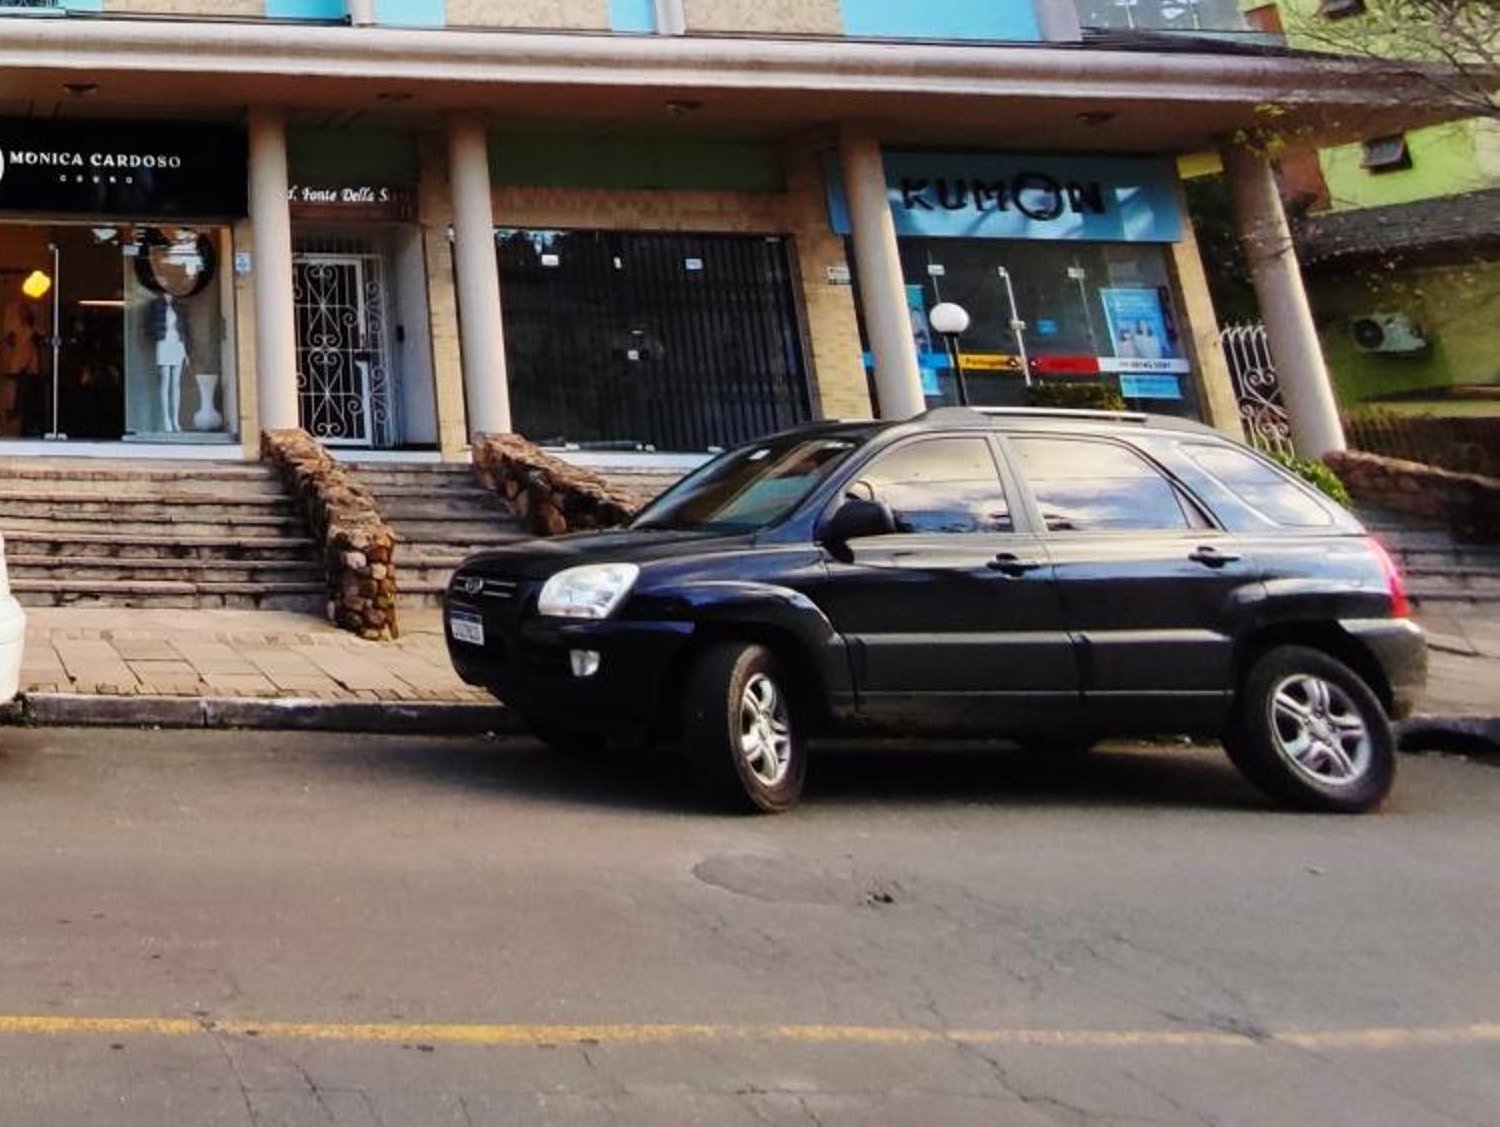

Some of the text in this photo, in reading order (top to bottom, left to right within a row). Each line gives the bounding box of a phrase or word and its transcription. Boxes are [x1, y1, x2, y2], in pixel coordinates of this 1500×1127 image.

[9, 150, 182, 169] MONICA CARDOSO
[901, 172, 1106, 221] KUMON
